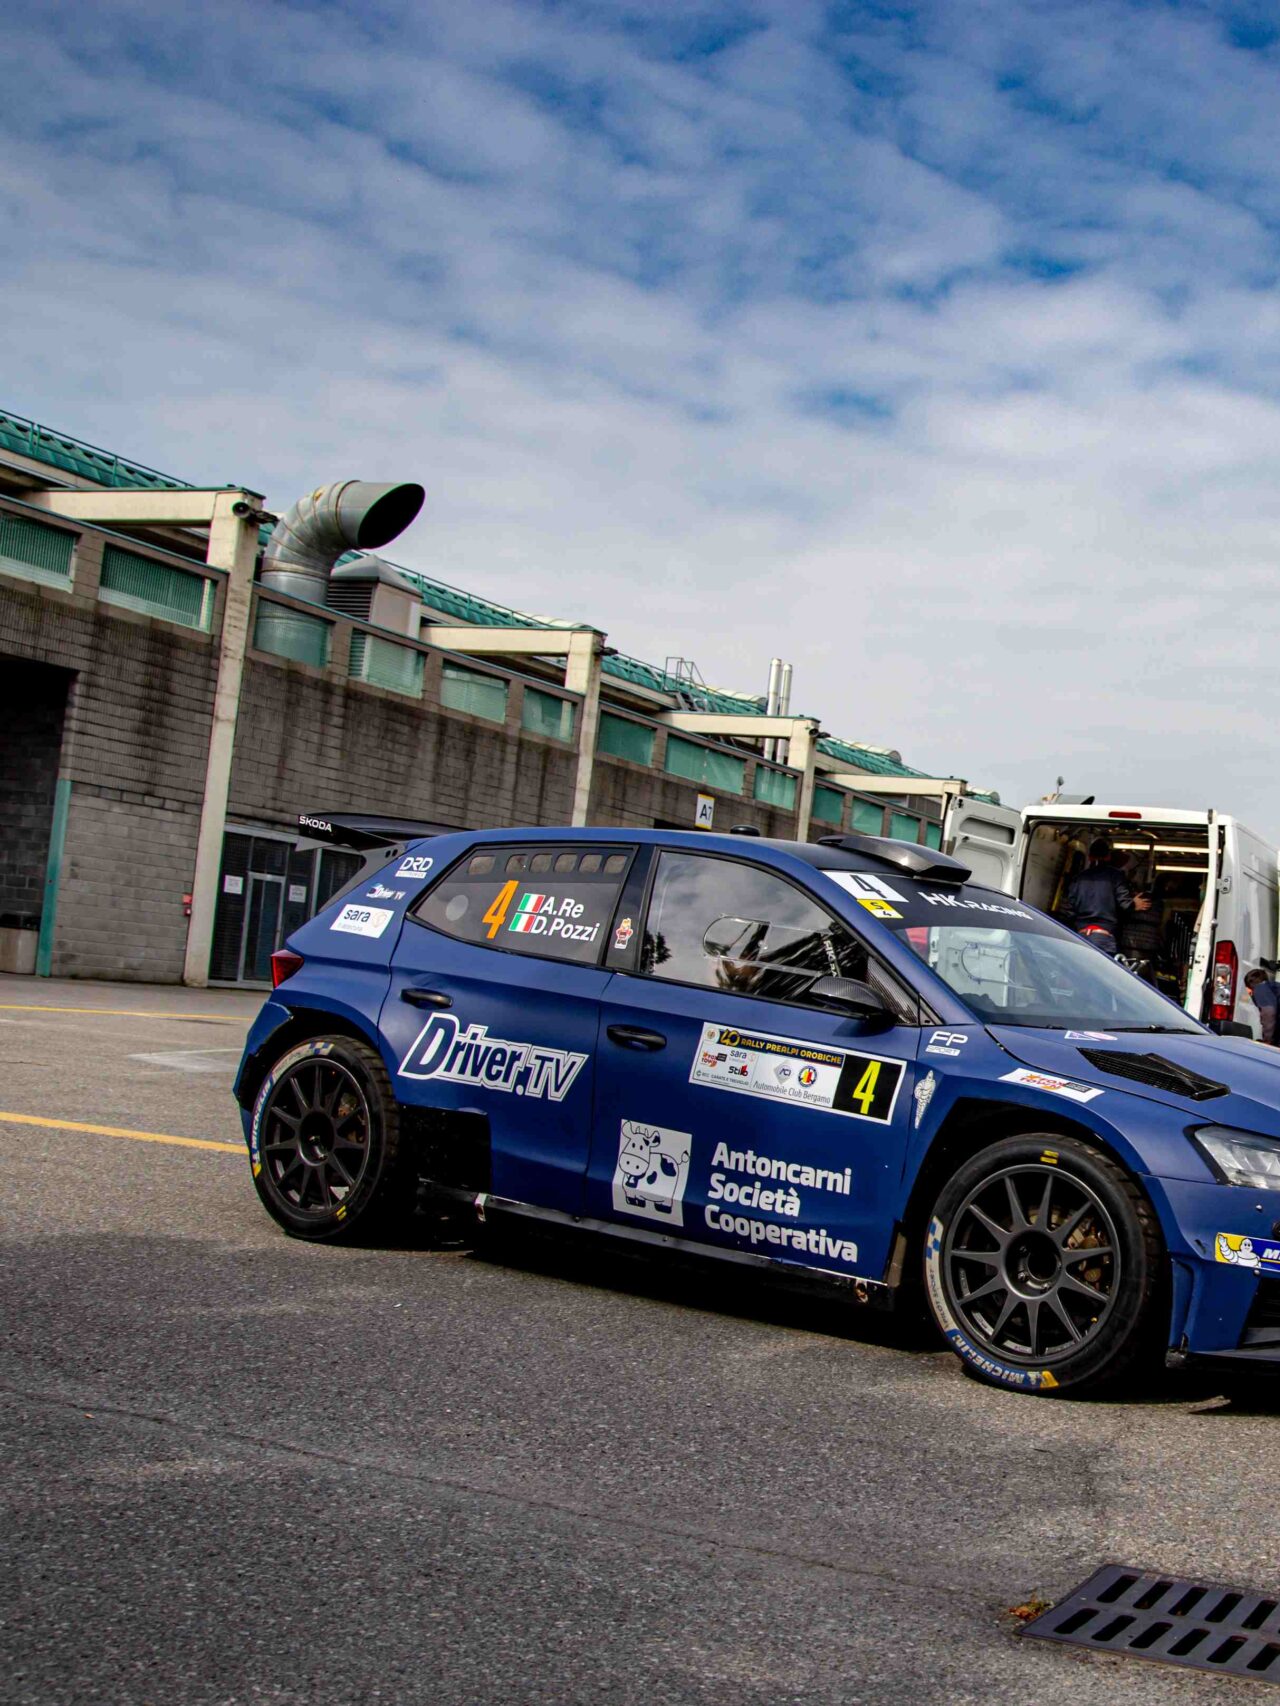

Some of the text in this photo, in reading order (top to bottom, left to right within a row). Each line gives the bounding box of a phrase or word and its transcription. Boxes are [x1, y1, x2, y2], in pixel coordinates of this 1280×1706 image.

[399, 856, 434, 871] DRD
[849, 874, 888, 899] 4
[343, 909, 371, 923] sara
[482, 879, 520, 940] 4
[539, 896, 585, 919] A.Re
[530, 915, 601, 942] D.Pozzi
[741, 1038, 765, 1049] RALLY
[766, 1042, 799, 1056] PREALPI
[800, 1049, 842, 1064] OROBICHE
[928, 1030, 969, 1047] FP
[753, 1080, 788, 1095] Automobile
[788, 1087, 802, 1097] Club
[803, 1090, 831, 1104] Bergamo
[852, 1060, 882, 1115] 4
[711, 1141, 852, 1196] Antoncarni
[707, 1172, 801, 1218] Società
[704, 1204, 859, 1263] Cooperativa
[952, 1334, 1026, 1384] MICHELIN
